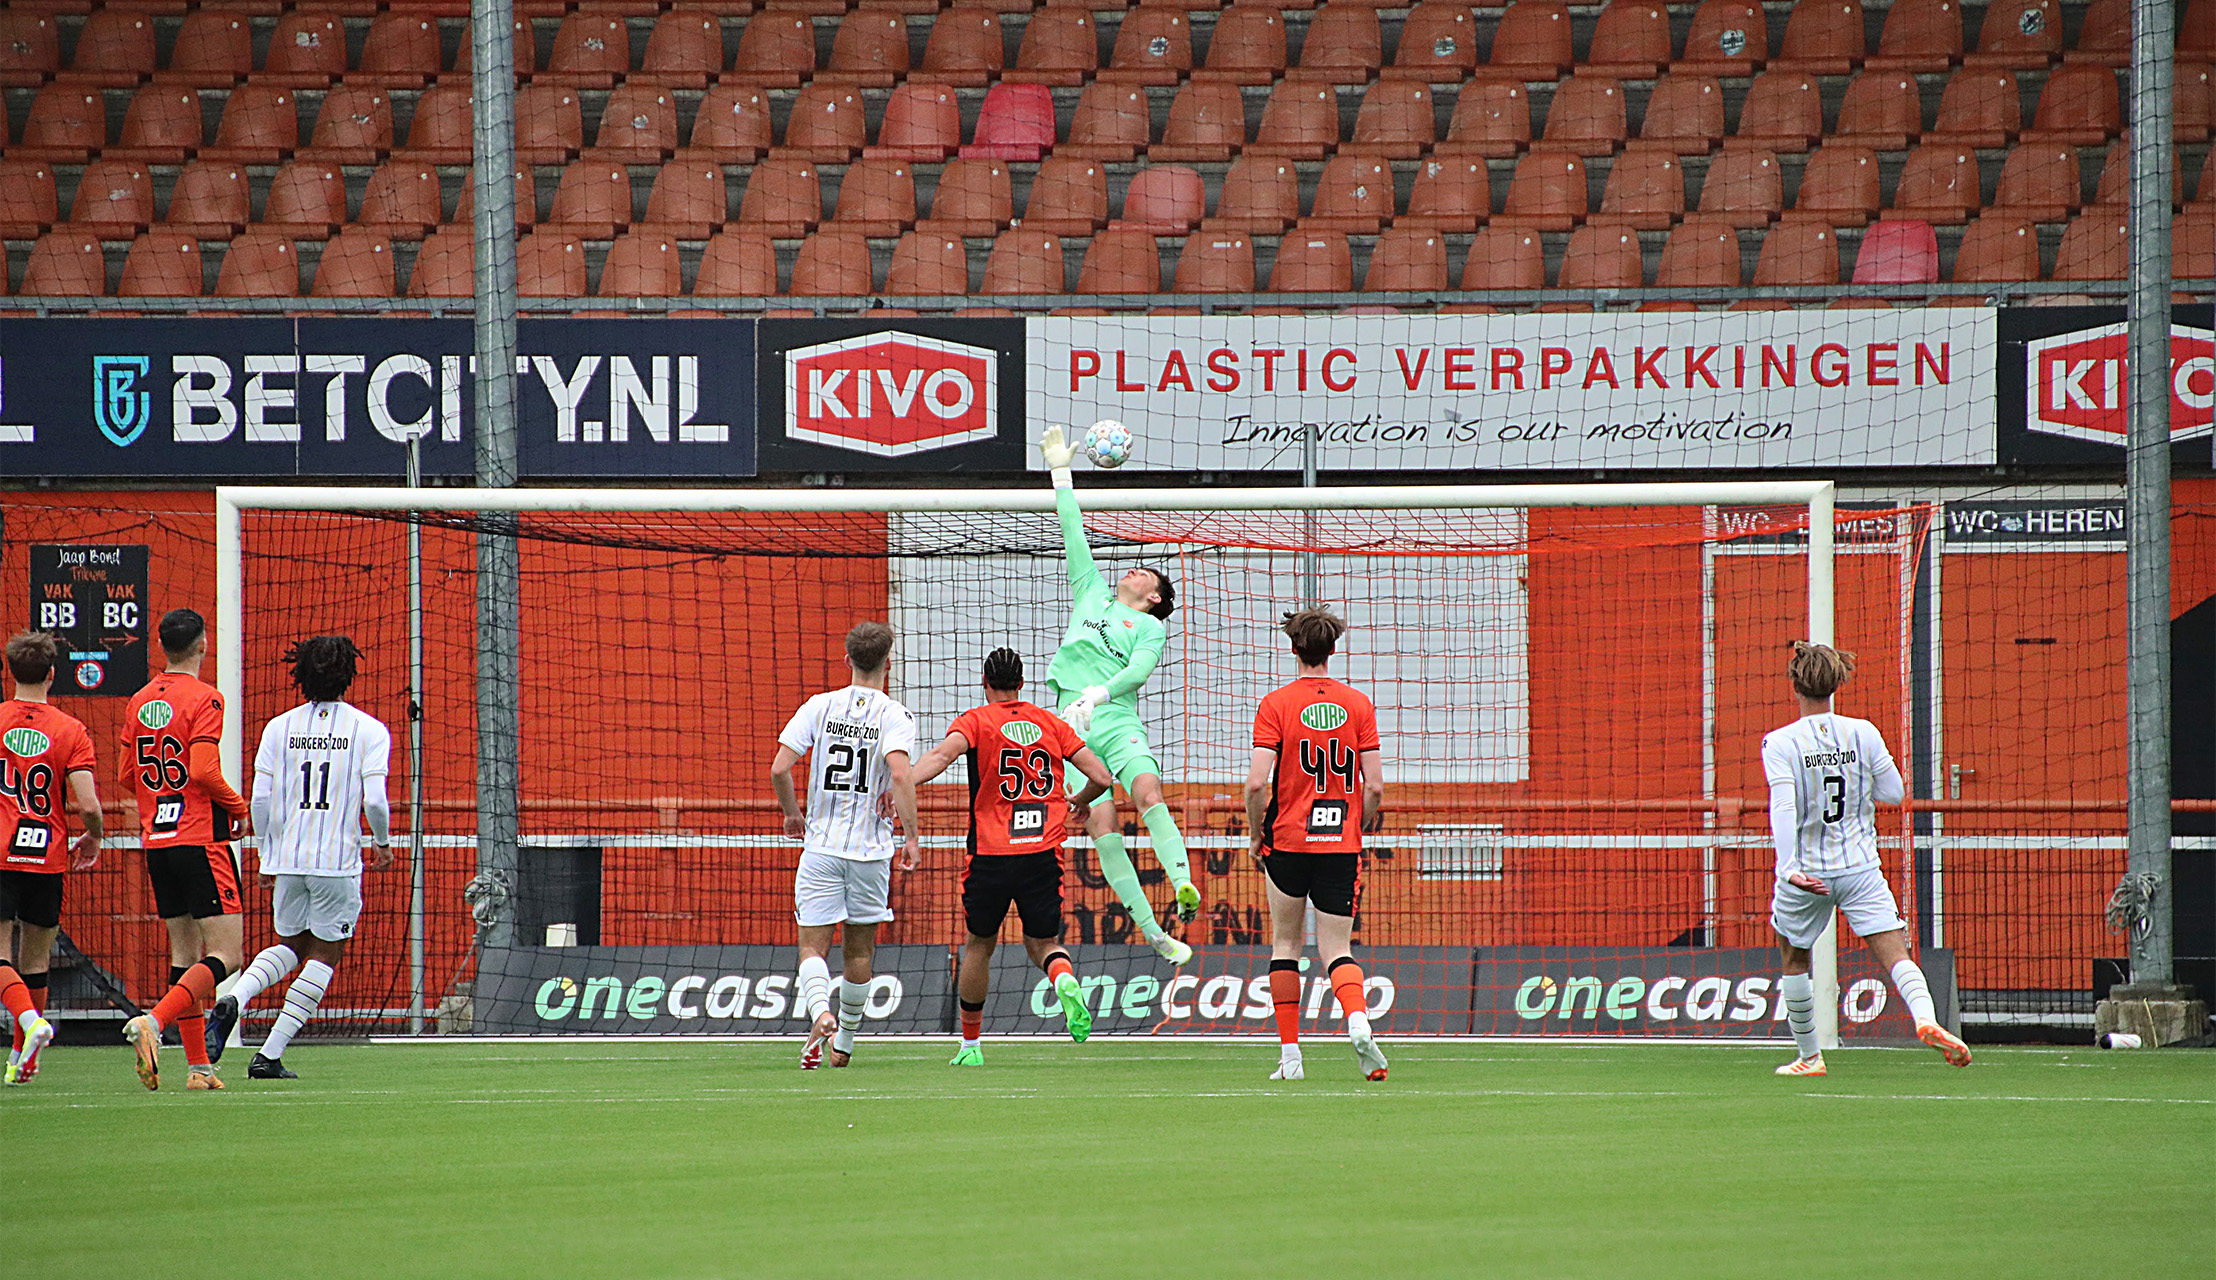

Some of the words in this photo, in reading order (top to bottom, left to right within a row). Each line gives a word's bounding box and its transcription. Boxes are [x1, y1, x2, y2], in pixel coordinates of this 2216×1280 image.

[1069, 347, 1358, 393] PLASTIC
[1395, 341, 1951, 391] VERPAKKINGEN
[809, 368, 974, 419] KIVO
[2052, 356, 2214, 410] KIO
[172, 354, 729, 443] BETCIY.NL
[1221, 413, 1428, 444] Innovation
[1446, 419, 1480, 441] is
[1498, 422, 1569, 441] our
[1586, 411, 1793, 442] motivation
[1723, 512, 1770, 534] WC
[1950, 510, 1999, 533] WC
[2026, 509, 2124, 533] HEREN
[57, 548, 86, 569] Jaap
[90, 548, 120, 565] Bond
[43, 584, 74, 599] VAK
[105, 584, 136, 599] VAK
[40, 602, 77, 628] BB
[103, 602, 139, 628] BC
[331, 737, 349, 750] ZOO
[863, 727, 879, 740] ZOO
[137, 735, 189, 791] 56
[823, 743, 869, 793] 21
[1300, 738, 1355, 793] 44
[1841, 750, 1856, 765] ZOO
[0, 758, 53, 816] 48
[299, 761, 330, 810] 11
[999, 748, 1054, 801] 53
[154, 802, 182, 824] BD
[1823, 775, 1846, 824] 3
[1014, 810, 1042, 830] BD
[1311, 807, 1343, 826] BD
[15, 827, 48, 848] BD
[534, 974, 903, 1021] onecaso
[1514, 975, 1888, 1023] onecaso
